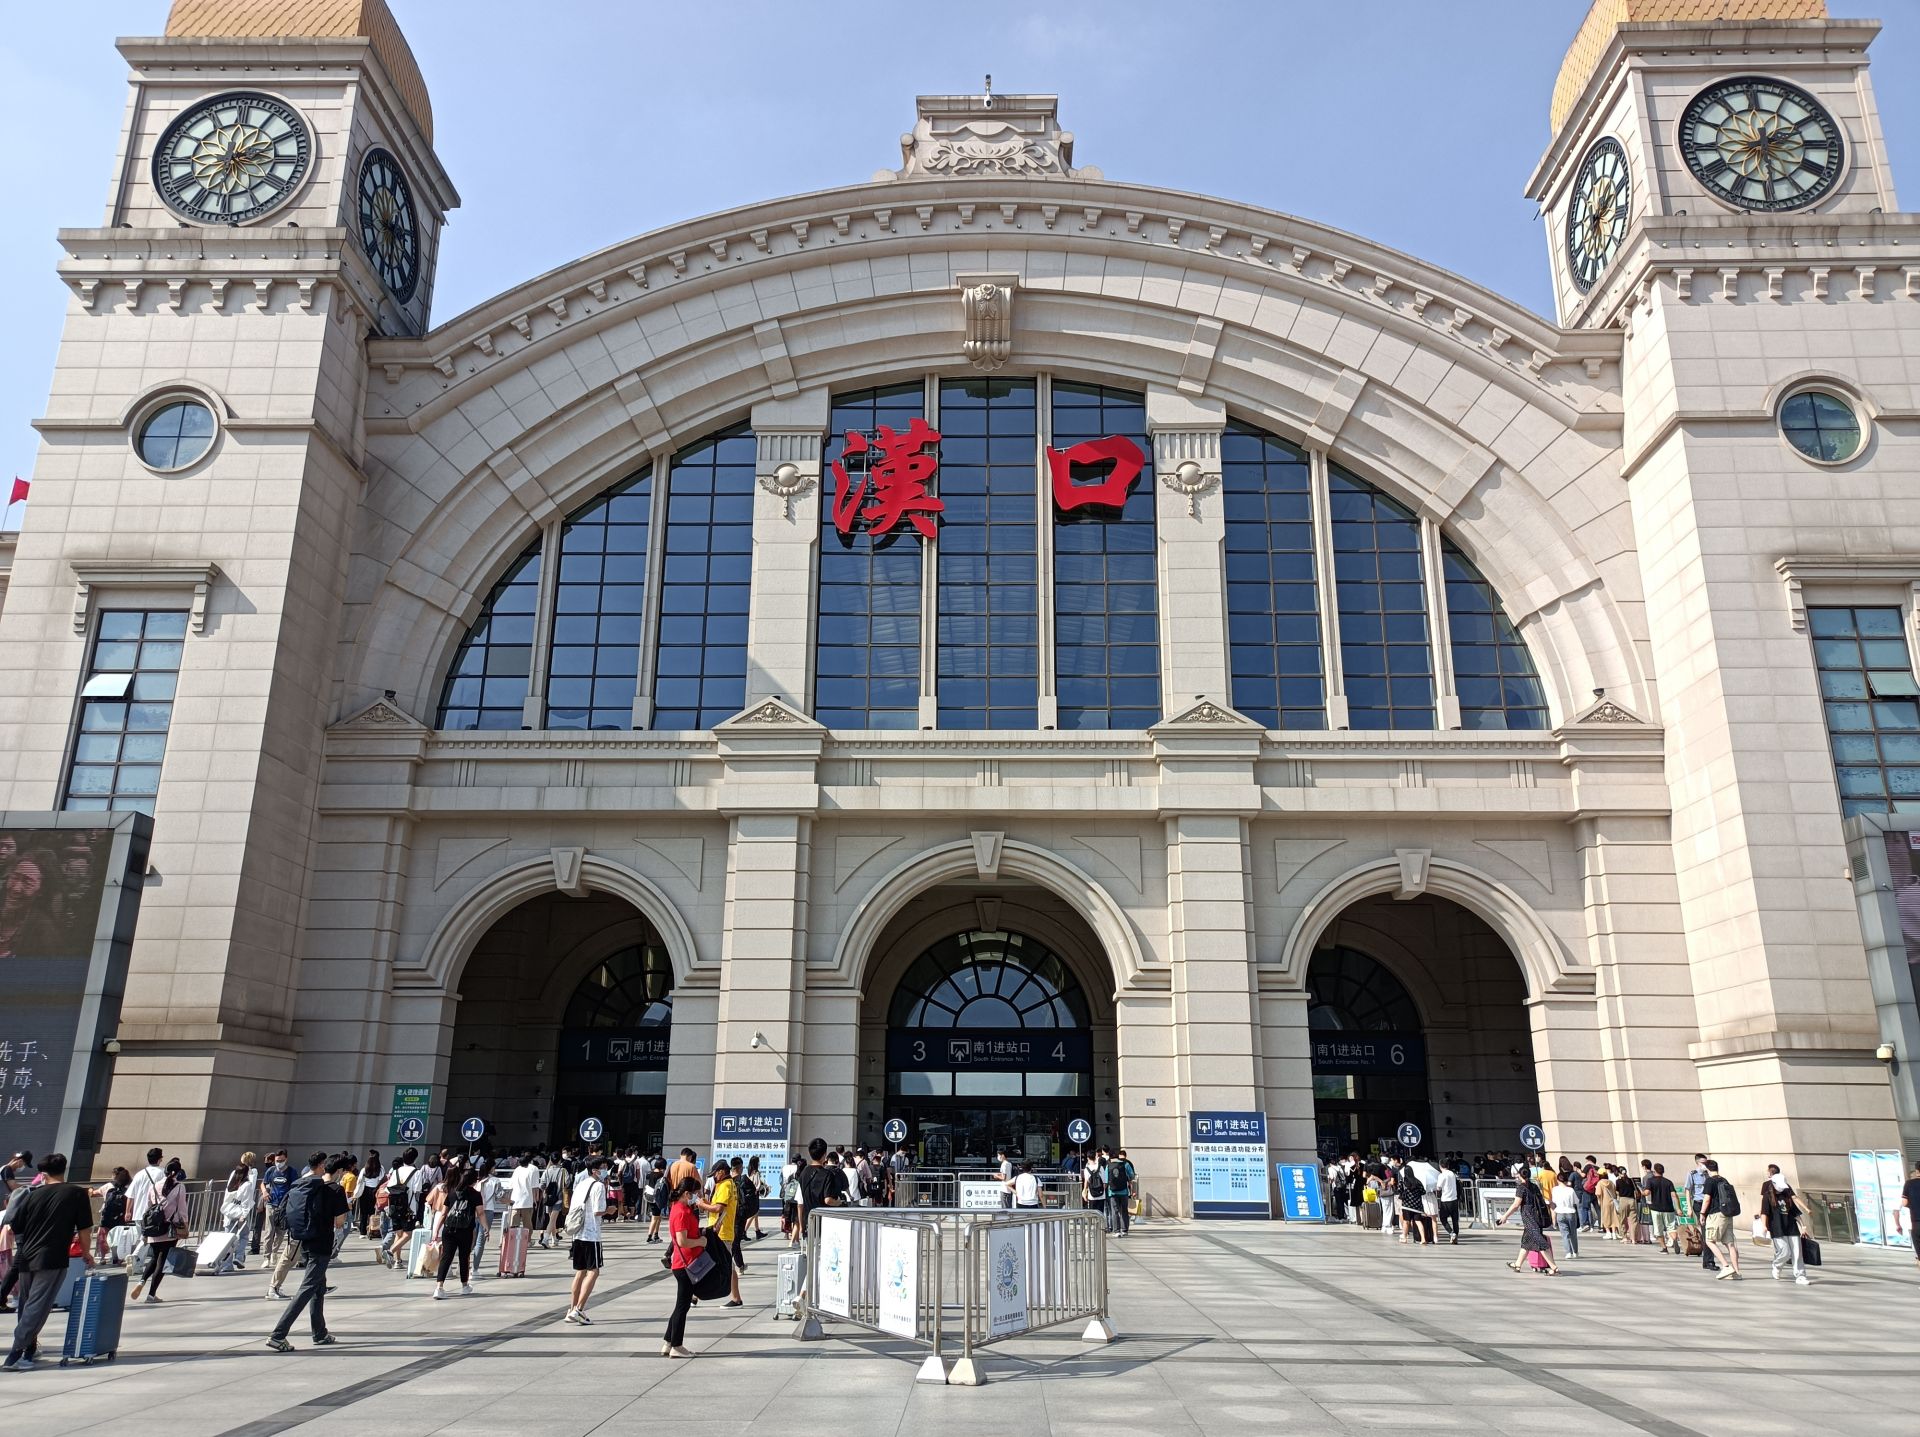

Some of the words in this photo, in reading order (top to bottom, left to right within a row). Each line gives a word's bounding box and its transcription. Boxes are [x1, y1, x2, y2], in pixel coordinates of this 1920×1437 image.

[582, 1040, 591, 1061] 1
[913, 1041, 926, 1061] 3
[973, 1041, 1030, 1054] 南1进站口
[1051, 1041, 1066, 1062] 4
[1316, 1043, 1375, 1056] 南1进站口
[1390, 1043, 1405, 1065] 6
[0, 1095, 38, 1117] 风。
[409, 1120, 416, 1130] 0
[470, 1120, 475, 1130] 1
[587, 1120, 594, 1130] 2
[738, 1117, 783, 1127] 南1进站口
[892, 1121, 899, 1131] 3
[1075, 1122, 1083, 1131] 4
[1214, 1120, 1259, 1130] 南1进站口
[404, 1130, 419, 1138] 通道
[465, 1130, 479, 1138] 通道
[888, 1131, 903, 1139] 通道
[1072, 1131, 1087, 1140] 通道
[1406, 1125, 1413, 1136] 5
[1528, 1127, 1536, 1138] 6
[1402, 1136, 1417, 1144] 通道
[1525, 1138, 1541, 1146] 通道
[716, 1142, 786, 1150] 南1进站口通道功能分布
[1194, 1145, 1265, 1153] 南1进站口通道功能分布
